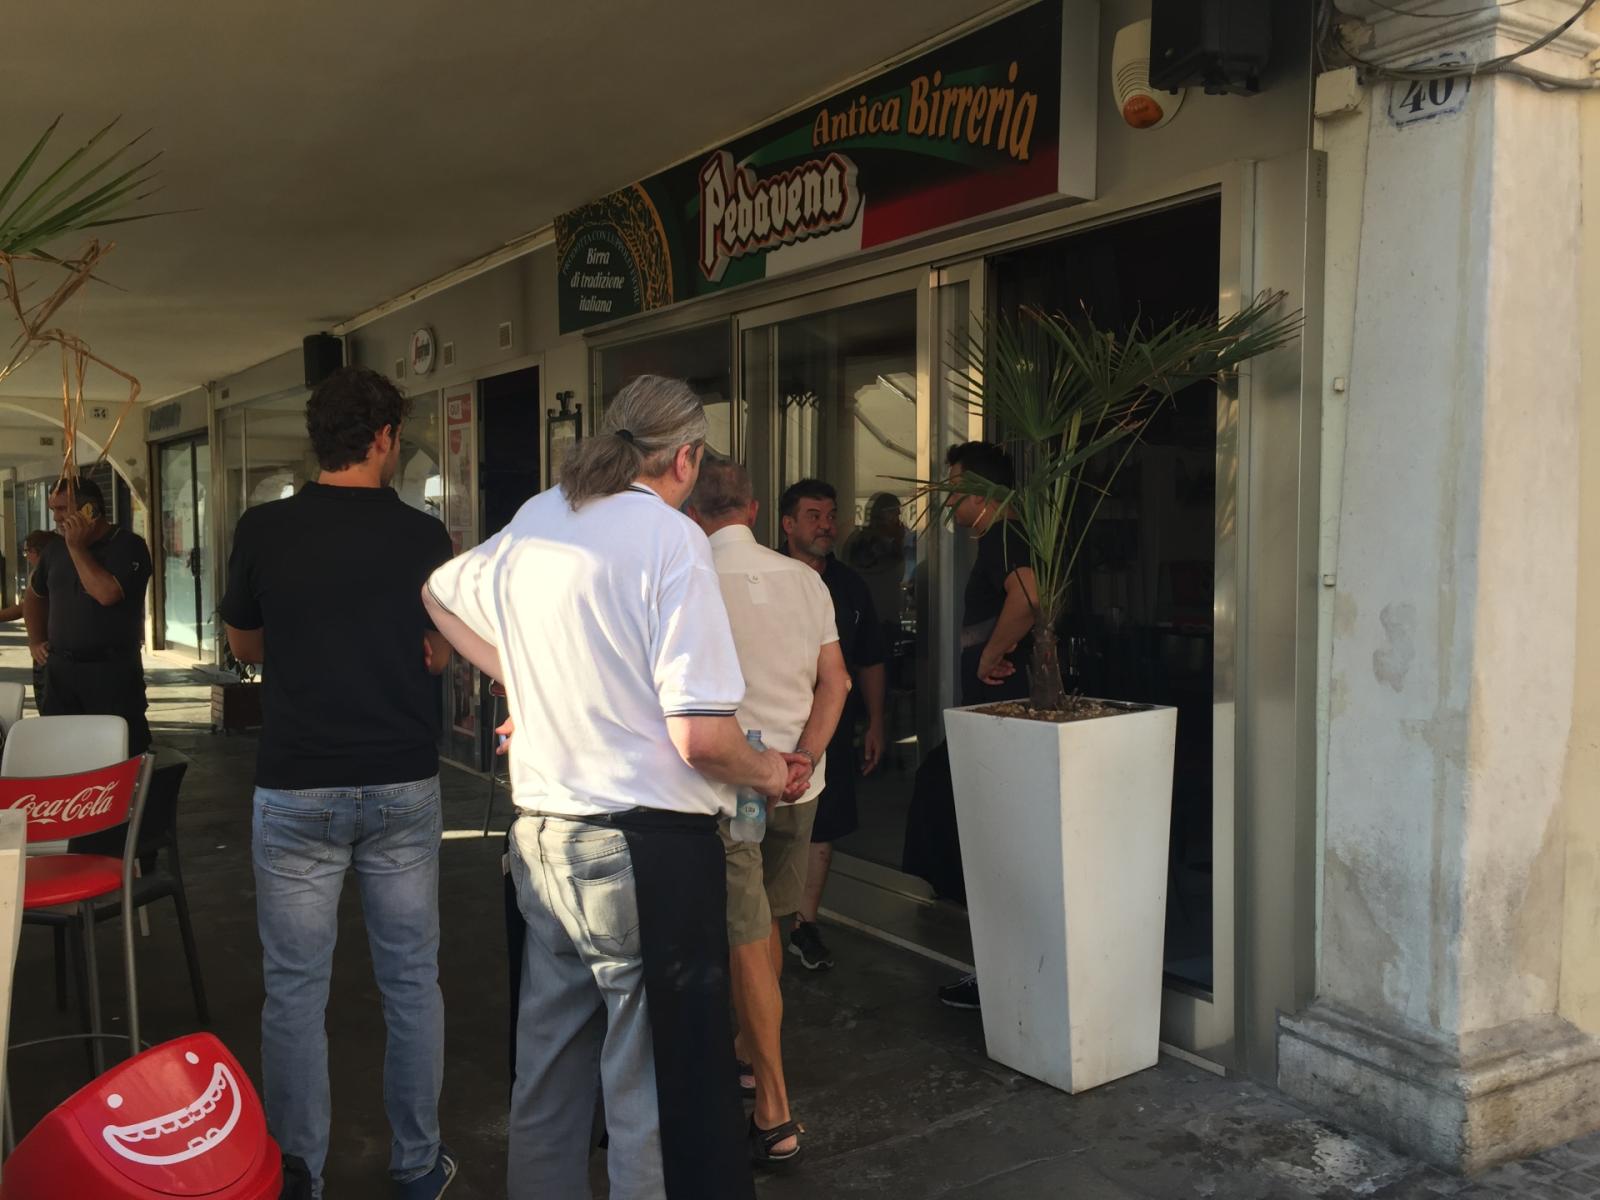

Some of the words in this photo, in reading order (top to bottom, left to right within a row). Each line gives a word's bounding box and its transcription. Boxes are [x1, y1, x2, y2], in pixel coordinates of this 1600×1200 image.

[1399, 62, 1456, 114] 40
[812, 95, 901, 147] Antica
[907, 61, 1038, 160] Birreria
[701, 152, 847, 277] Pedavena
[586, 247, 611, 265] Birra
[570, 271, 580, 289] di
[580, 271, 625, 289] tradizione
[579, 295, 613, 313] italiana
